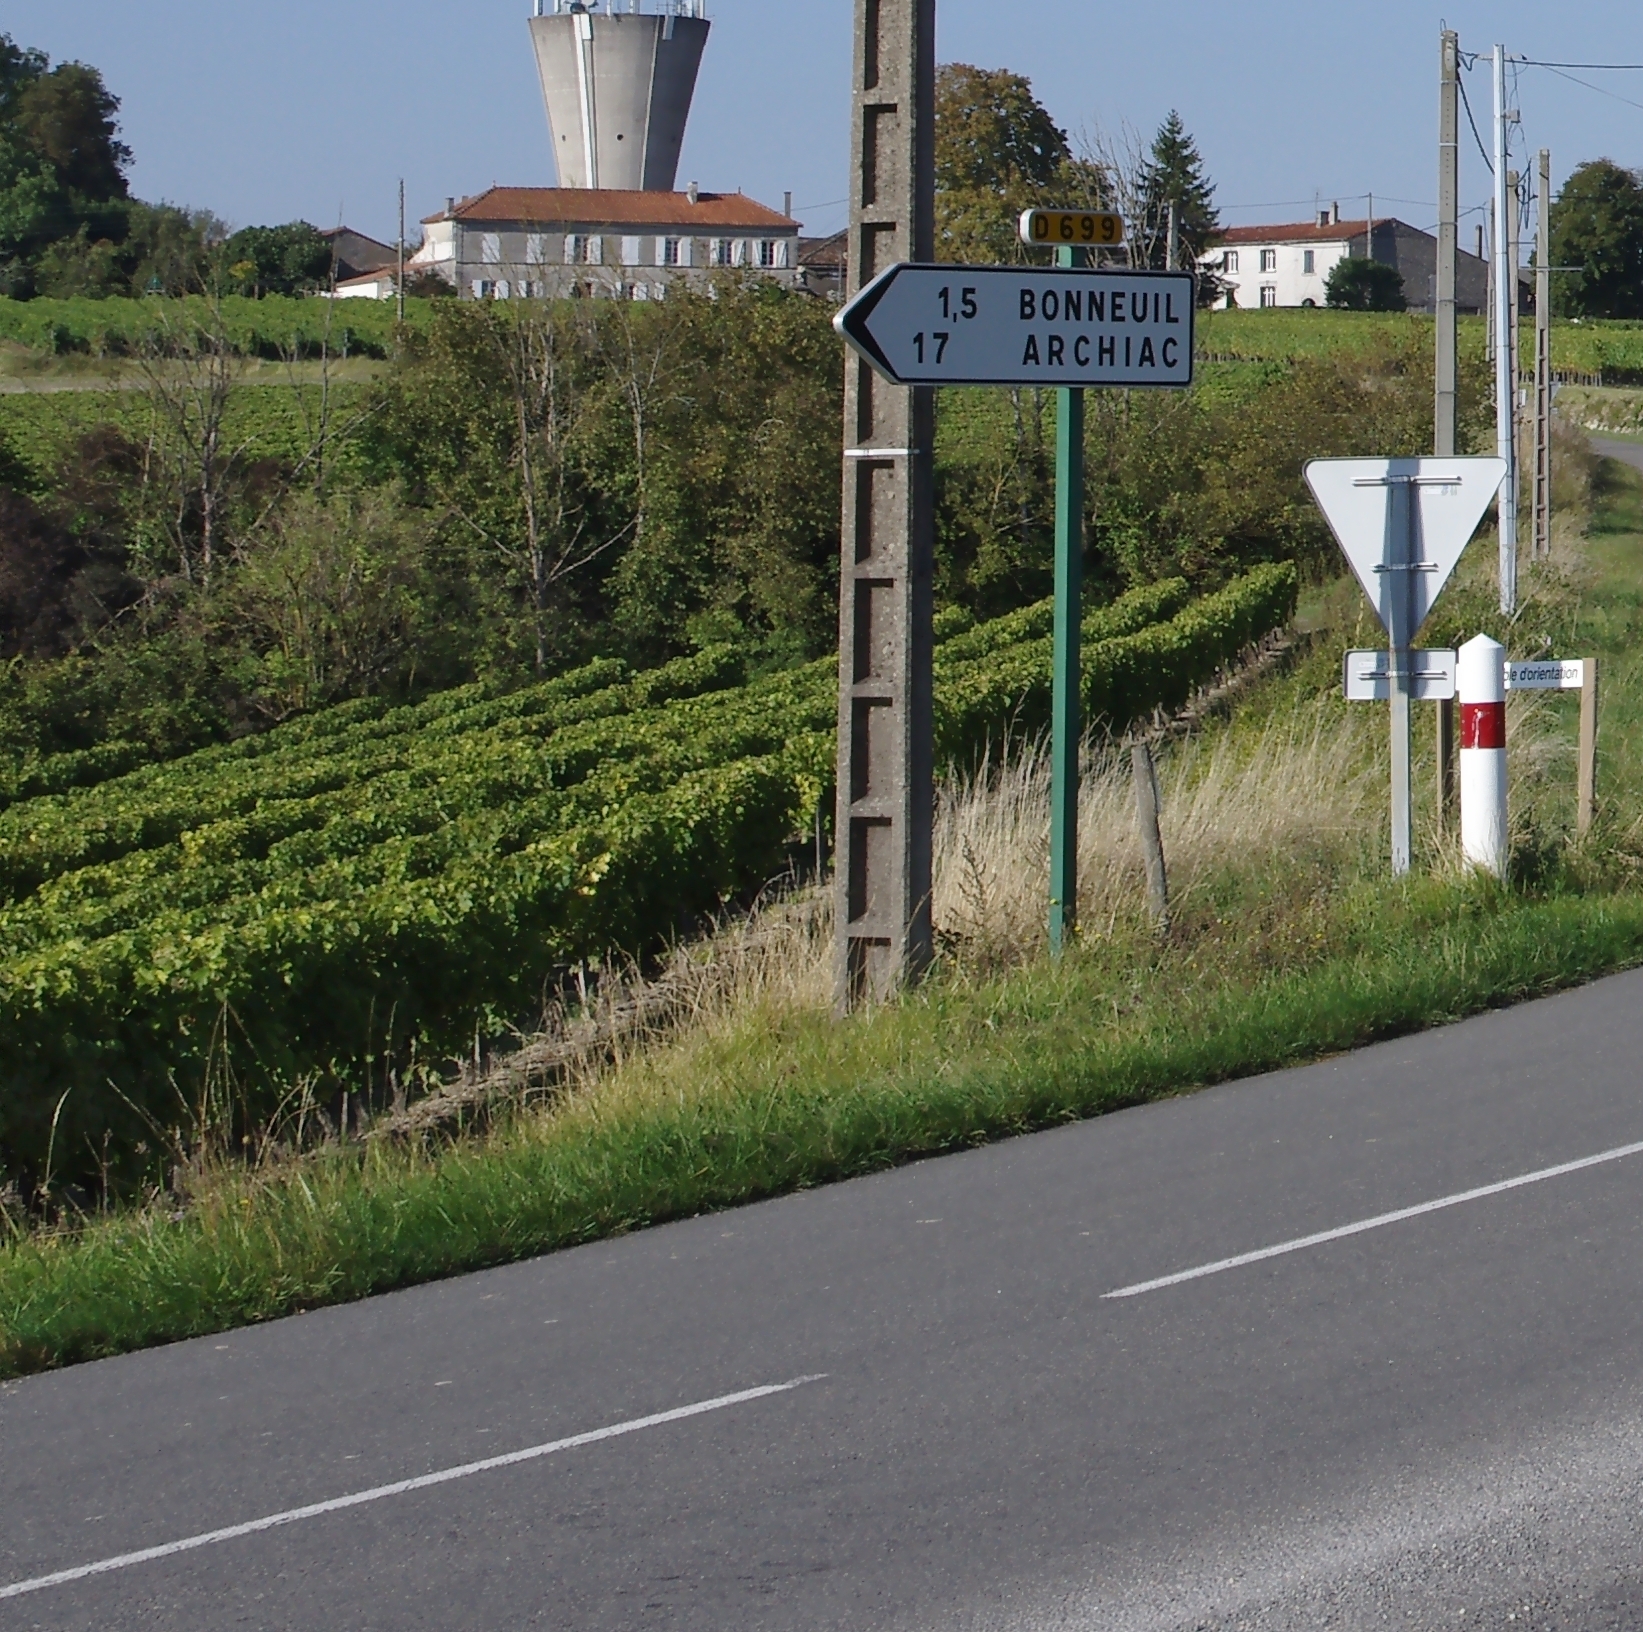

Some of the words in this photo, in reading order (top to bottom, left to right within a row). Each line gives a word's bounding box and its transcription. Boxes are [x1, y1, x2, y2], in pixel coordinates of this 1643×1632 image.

[1034, 215, 1049, 238] D
[1059, 216, 1115, 241] 699
[938, 286, 977, 323] 1,5
[1019, 288, 1179, 323] BONNEUIL
[913, 332, 949, 364] 17
[1022, 334, 1178, 368] ARCHIAC
